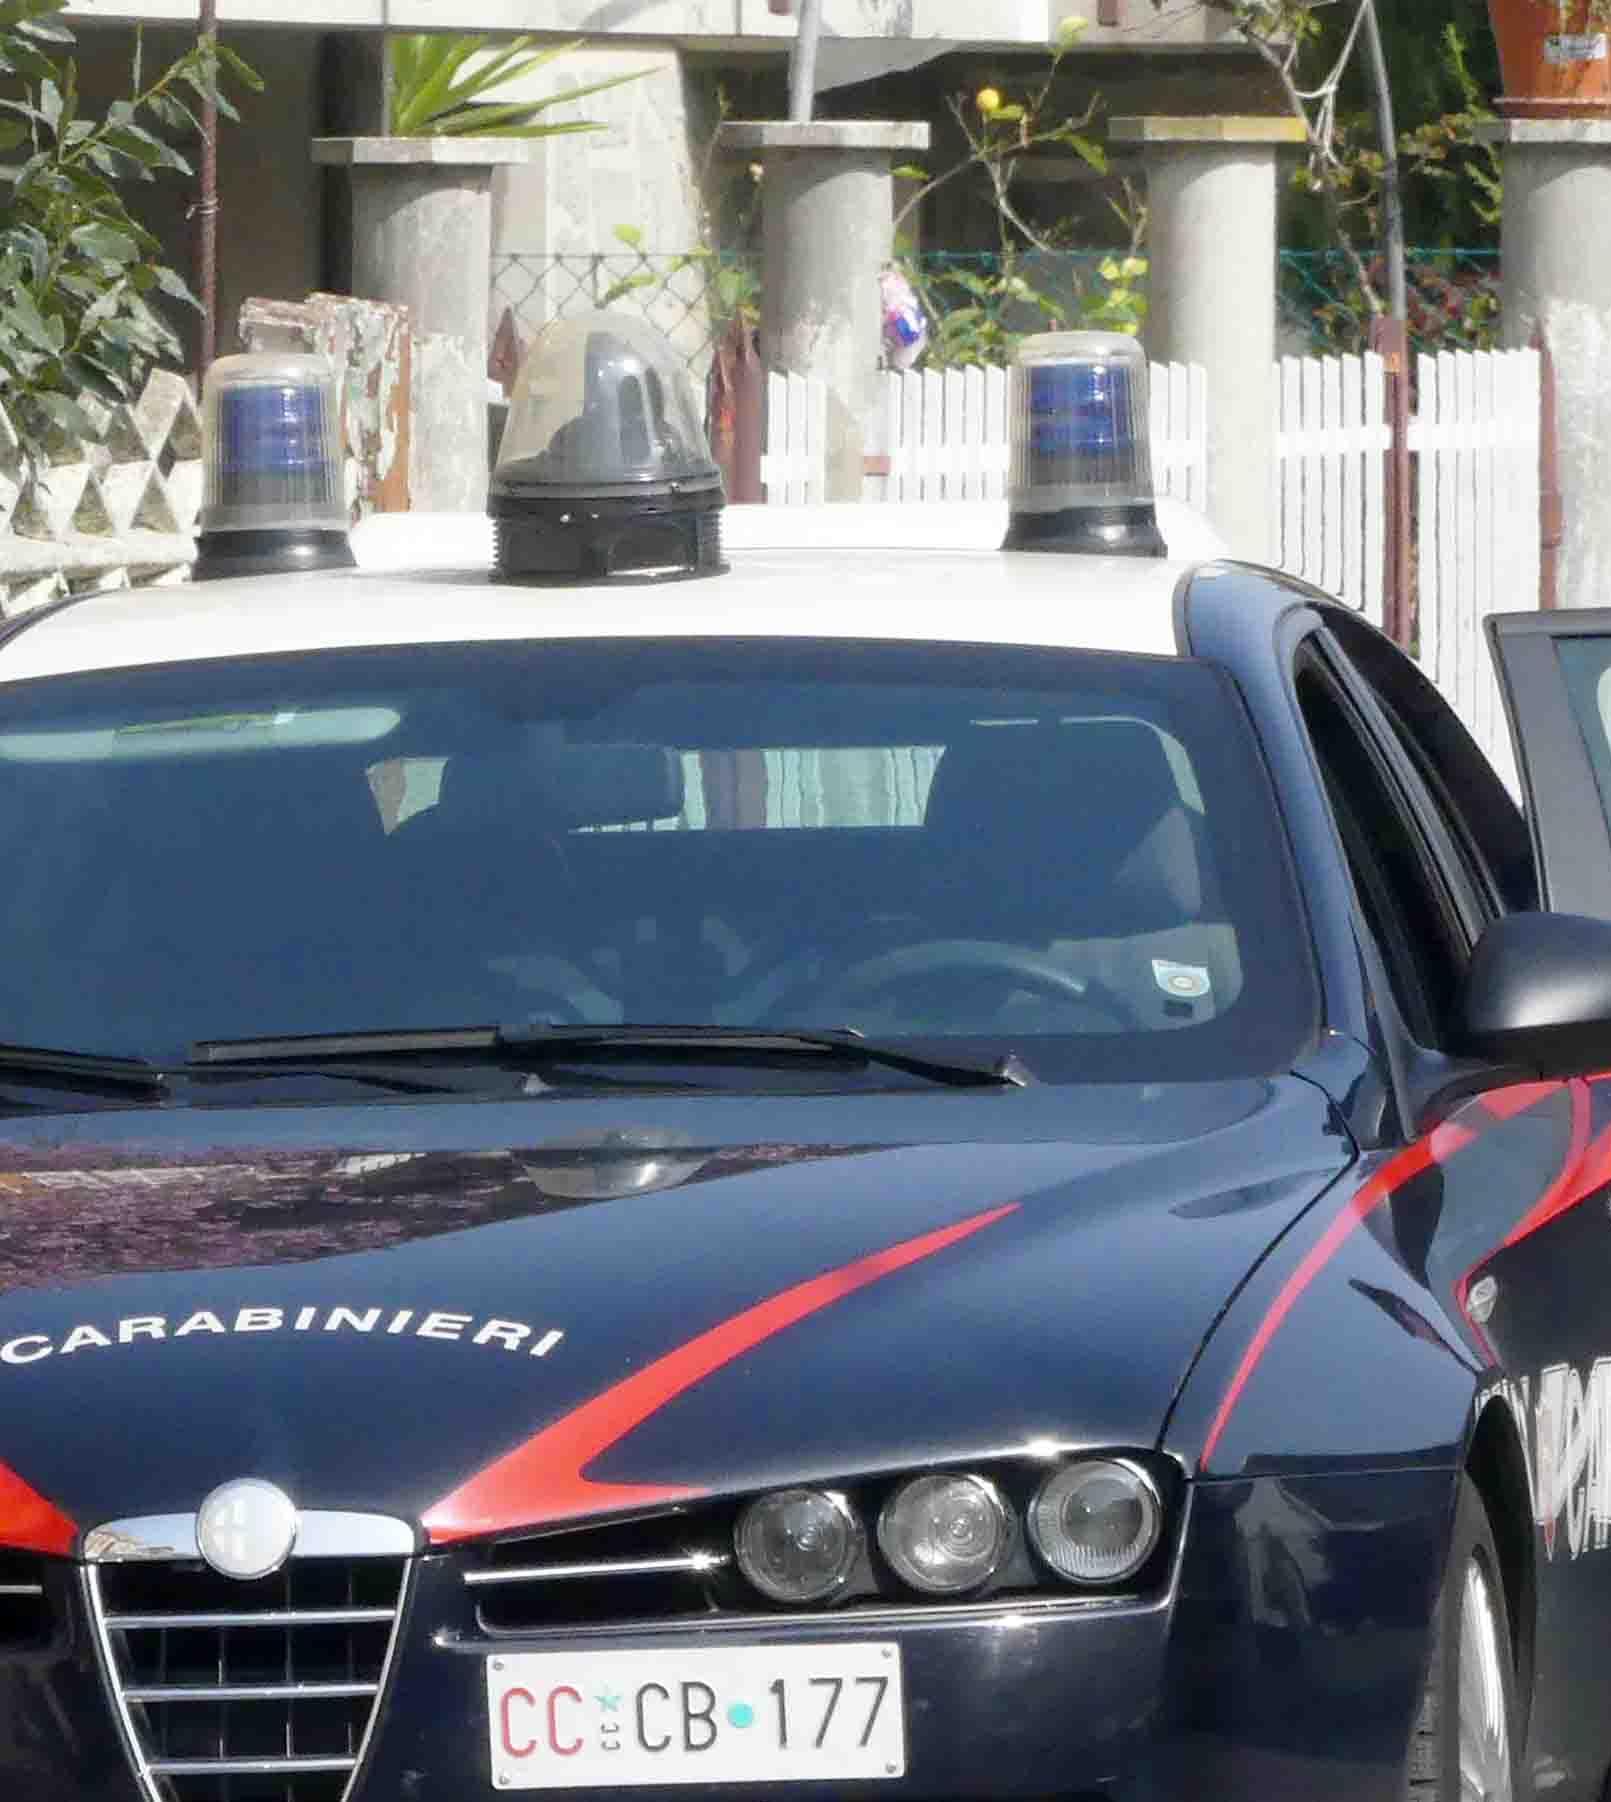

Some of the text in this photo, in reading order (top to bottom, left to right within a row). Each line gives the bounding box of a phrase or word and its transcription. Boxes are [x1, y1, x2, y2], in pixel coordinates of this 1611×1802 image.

[0, 1306, 565, 1364] CARABINIERI
[500, 1685, 584, 1757] CC
[769, 1676, 889, 1750] 177
